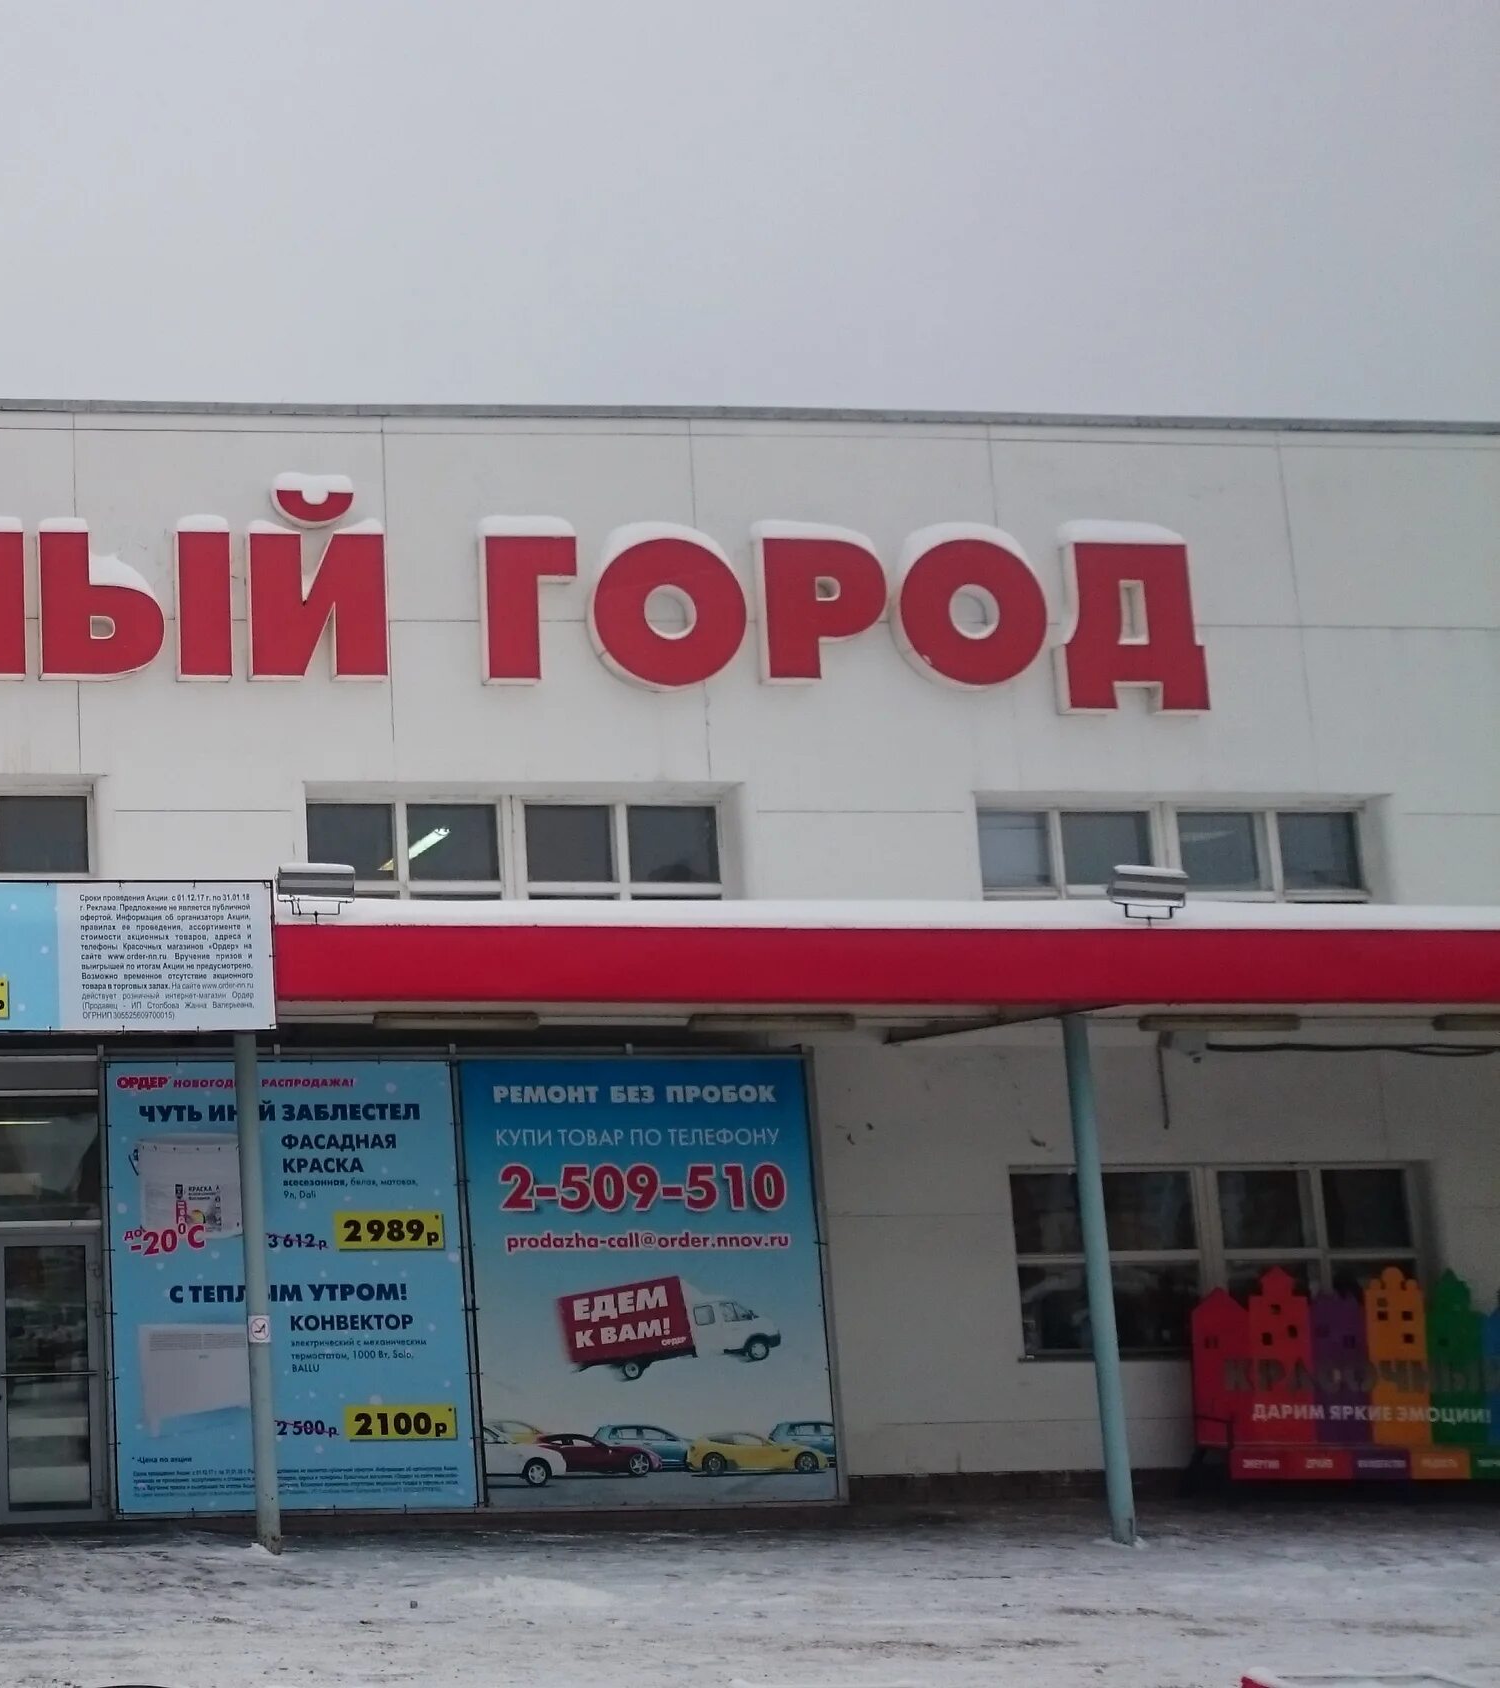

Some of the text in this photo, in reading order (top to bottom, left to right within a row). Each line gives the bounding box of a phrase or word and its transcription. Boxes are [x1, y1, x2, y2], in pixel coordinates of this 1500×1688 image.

[481, 530, 1211, 714] ГОРОД
[116, 914, 162, 922] Информация
[123, 943, 162, 951] Красочных
[196, 963, 252, 971] предусмотрено.
[213, 972, 253, 980] акционного
[116, 1076, 354, 1090] ОРДЕР РАСПРОДАЖА!
[493, 1085, 777, 1104] РЕМОНТ БЕЗ ПРОБОК
[139, 1100, 420, 1122] ЧУТЬ ИНЙ ЗАБЛЕСТЕЛ
[281, 1133, 397, 1151] ФАСАДНАЯ
[496, 1127, 780, 1148] КУПИ ТОВАР ПО ТЕЛЕФОНУ
[283, 1157, 364, 1173] КРАСКА
[283, 1178, 349, 1188] всесезонная,
[380, 1178, 418, 1187] матовая,
[500, 1162, 787, 1212] 2-509-510
[284, 1190, 298, 1200] 9л,
[124, 1229, 143, 1240] до
[506, 1232, 790, 1252] prodazha-call@order.nnov.ru
[170, 1286, 183, 1303] С
[309, 1284, 407, 1301] УТРОМ!
[572, 1285, 668, 1323] ЕДЕМ
[290, 1314, 413, 1331] КОНВЕКТОР
[575, 1318, 671, 1349] К ВАМ!
[290, 1337, 427, 1348] электрический механическим
[292, 1351, 350, 1361] термостатом,
[353, 1350, 376, 1359] 1000
[292, 1364, 320, 1373] BALLU
[1252, 1404, 1491, 1425] ДАРИМ ЯРКИЕ ЭМОЦИИ!
